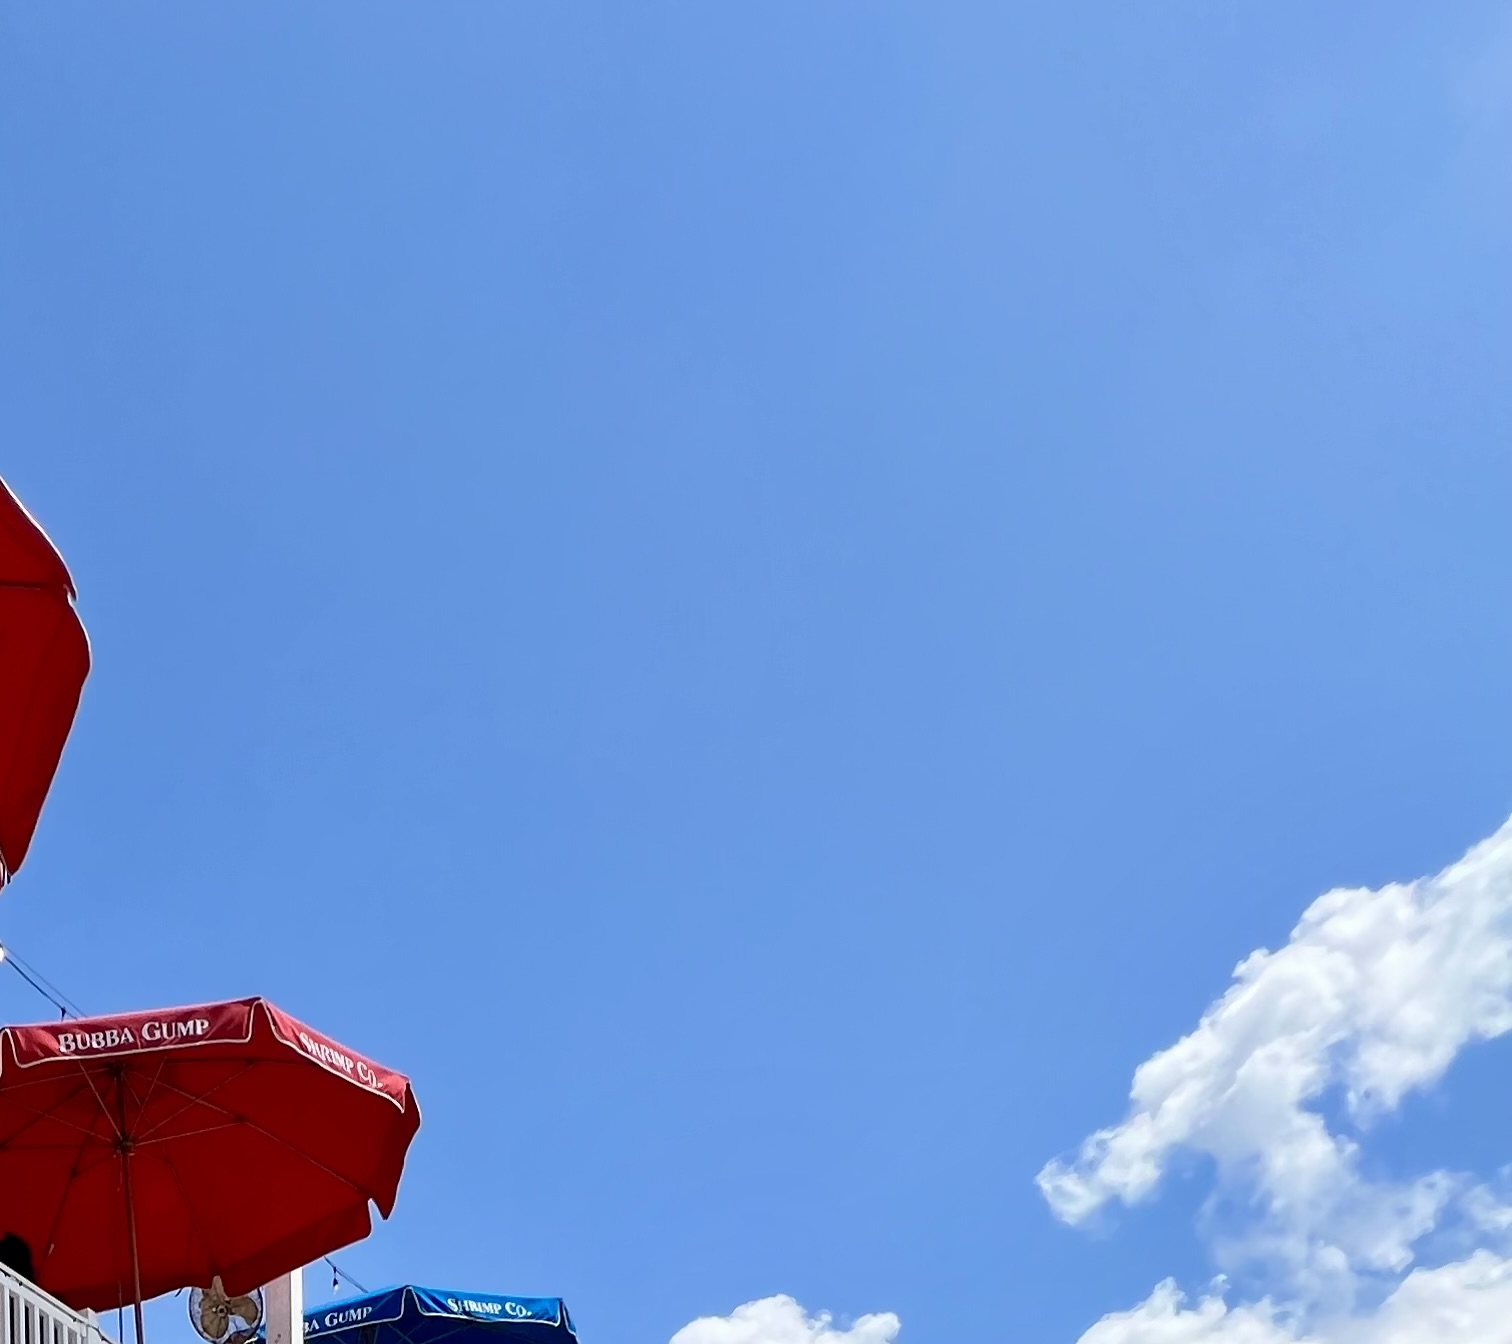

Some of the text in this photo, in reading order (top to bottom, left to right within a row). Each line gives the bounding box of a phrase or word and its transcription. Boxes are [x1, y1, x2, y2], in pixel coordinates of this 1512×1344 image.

[58, 1018, 209, 1053] BUBBA GUMP
[299, 1032, 354, 1074] SHRIMP
[324, 1305, 373, 1328] GUMP
[447, 1297, 533, 1317] SHRIMP CO.
